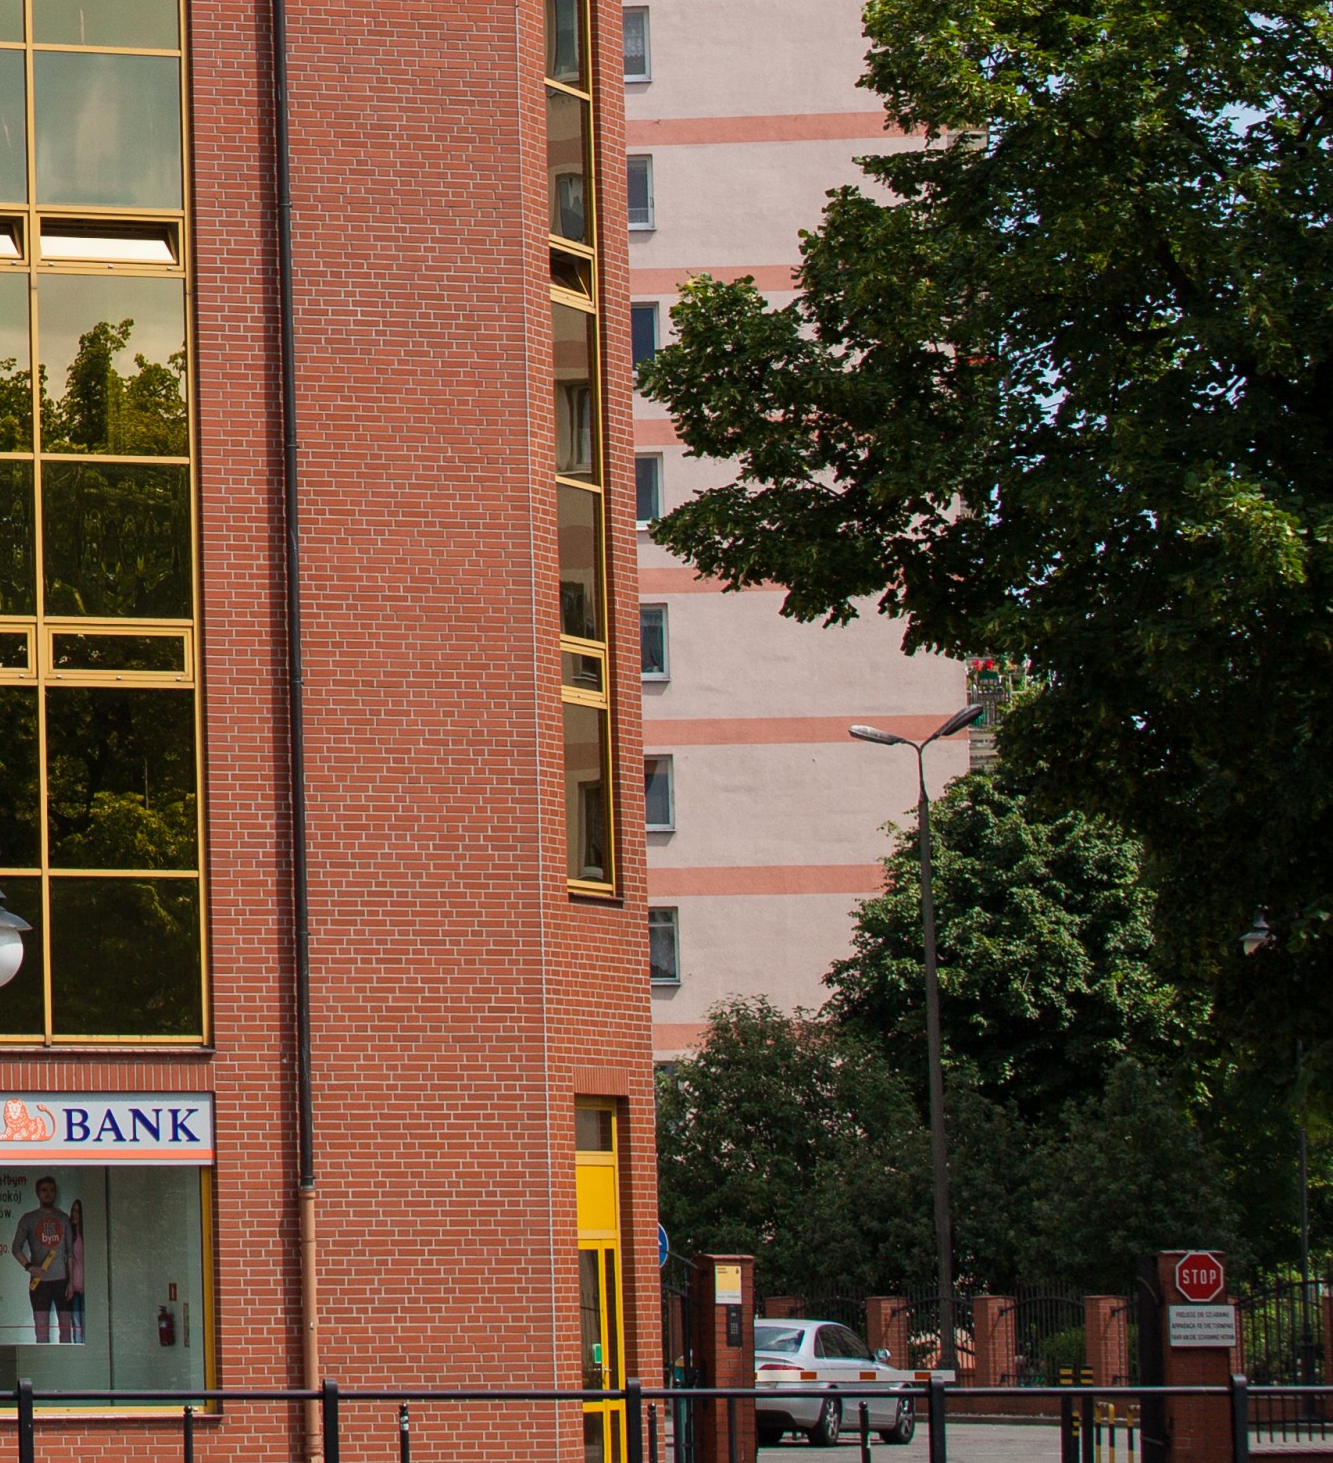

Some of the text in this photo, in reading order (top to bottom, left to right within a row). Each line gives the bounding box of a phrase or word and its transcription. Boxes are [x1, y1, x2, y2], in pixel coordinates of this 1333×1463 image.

[63, 1108, 200, 1142] BANK
[41, 1232, 60, 1245] bym
[1182, 1269, 1217, 1285] STOP
